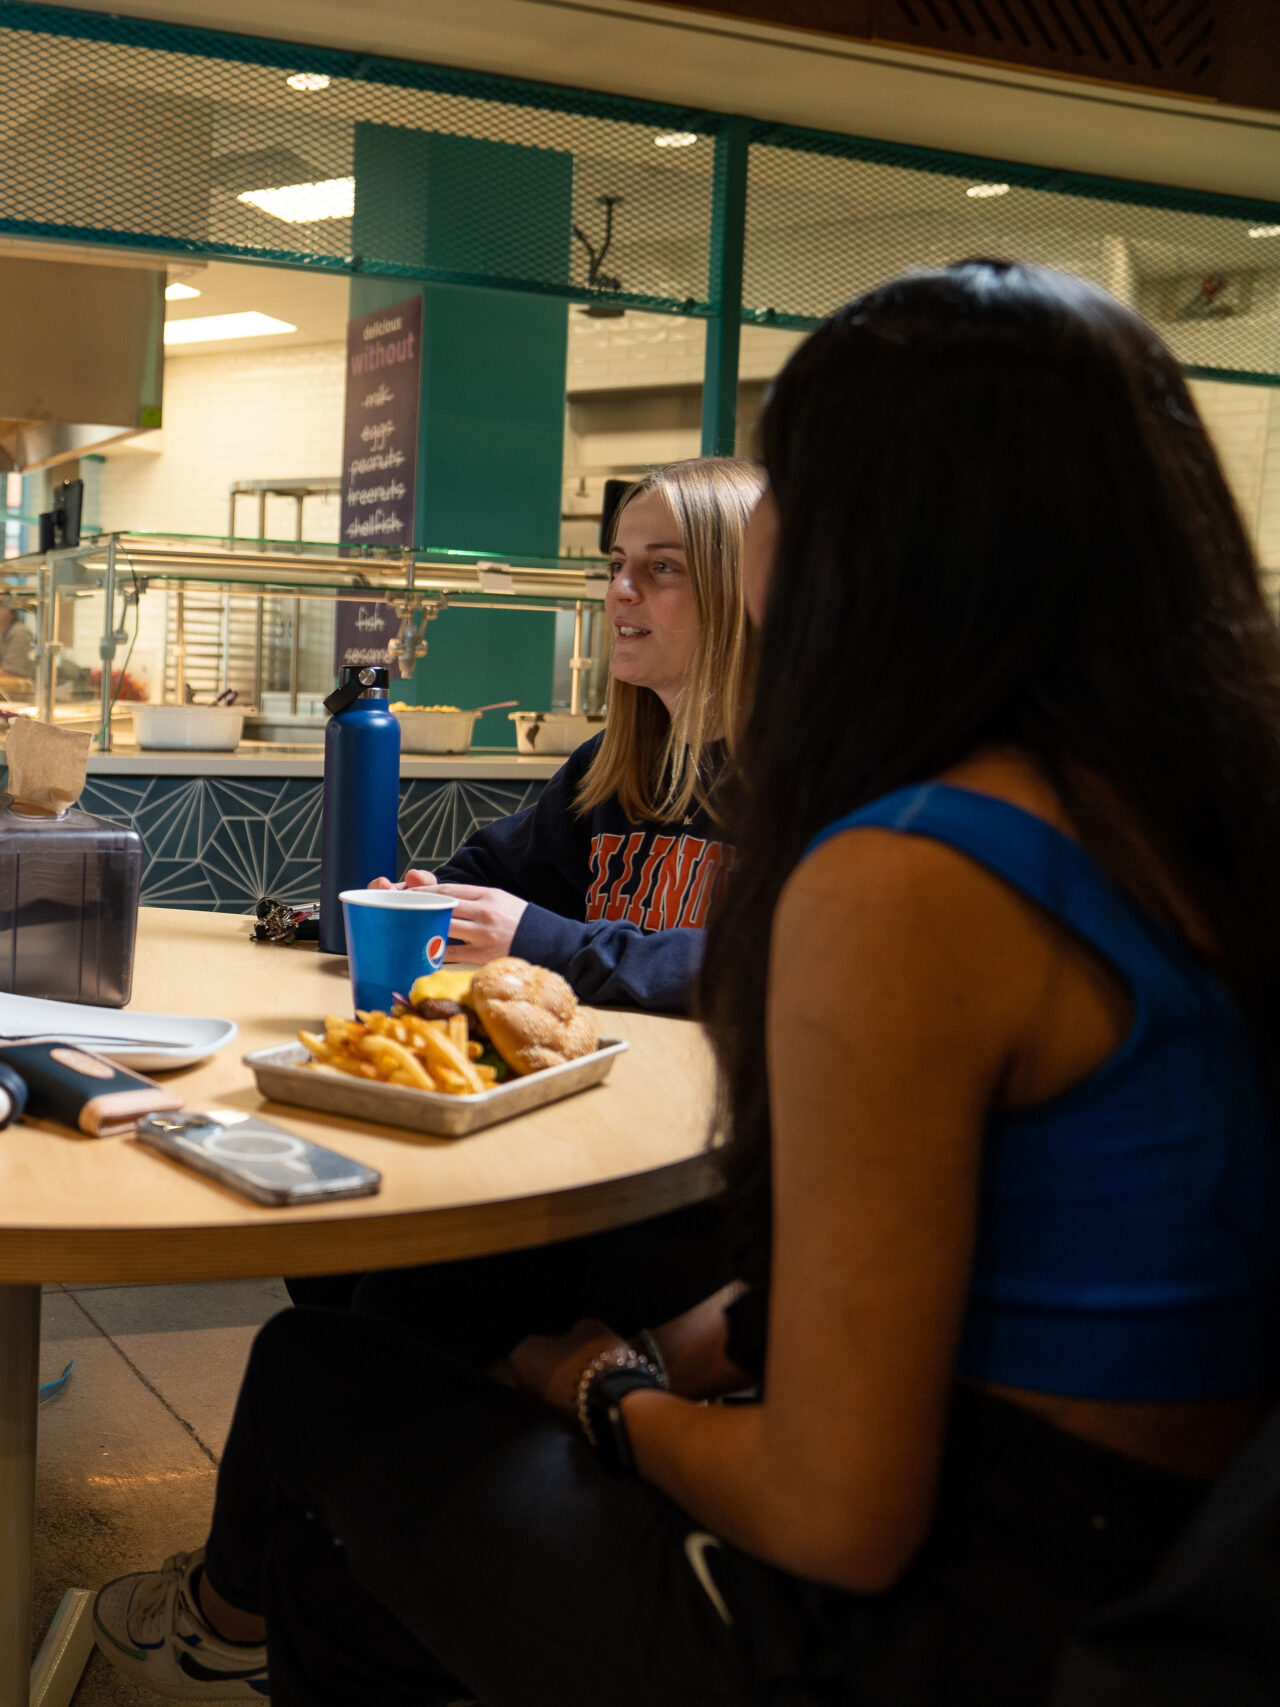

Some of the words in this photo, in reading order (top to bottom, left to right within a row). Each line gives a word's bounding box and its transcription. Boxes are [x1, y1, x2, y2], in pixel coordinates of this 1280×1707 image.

[363, 316, 403, 341] delicious
[351, 331, 415, 376] without
[361, 420, 395, 452] eggs
[349, 446, 406, 485] peanuts
[346, 508, 405, 538] shellfish
[586, 832, 735, 932] LLINO
